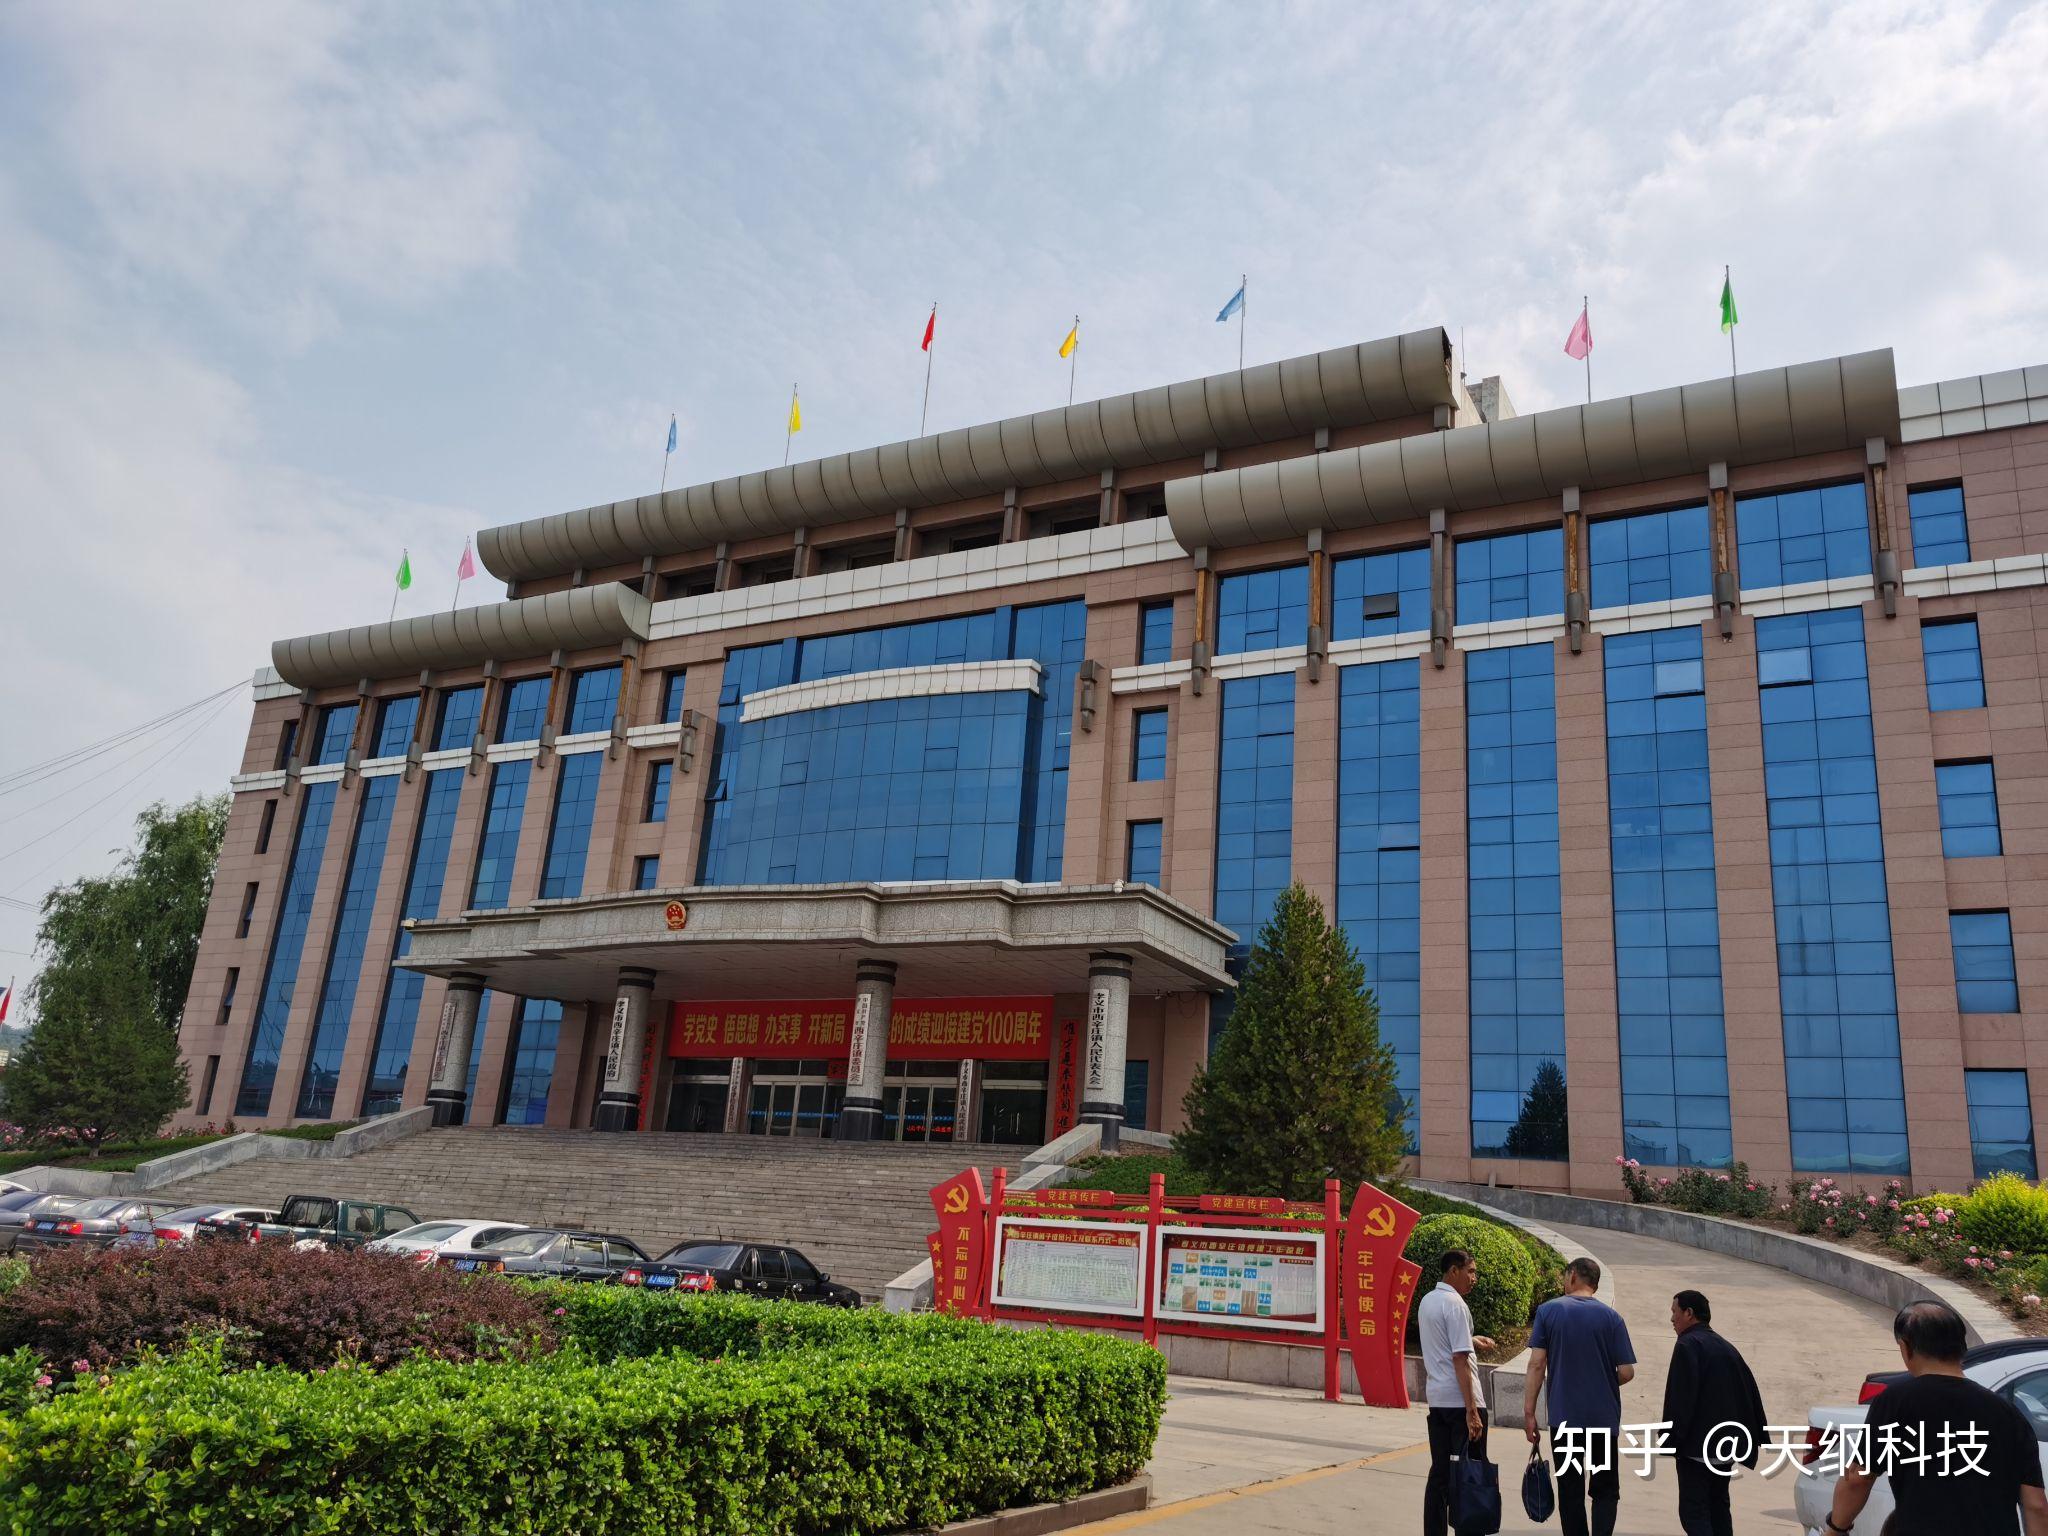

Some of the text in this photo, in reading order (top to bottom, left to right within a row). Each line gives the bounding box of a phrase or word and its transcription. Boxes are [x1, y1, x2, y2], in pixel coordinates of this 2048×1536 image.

[683, 1011, 1042, 1045] 学党史 悟思想 办实事 开新局 的成绩迎接建党100周年
[1048, 1190, 1100, 1203] 党建宣传栏
[1212, 1197, 1269, 1210] 党建宣传栏
[953, 1226, 971, 1300] 不忘初心
[1357, 1251, 1376, 1335] 牢记使命
